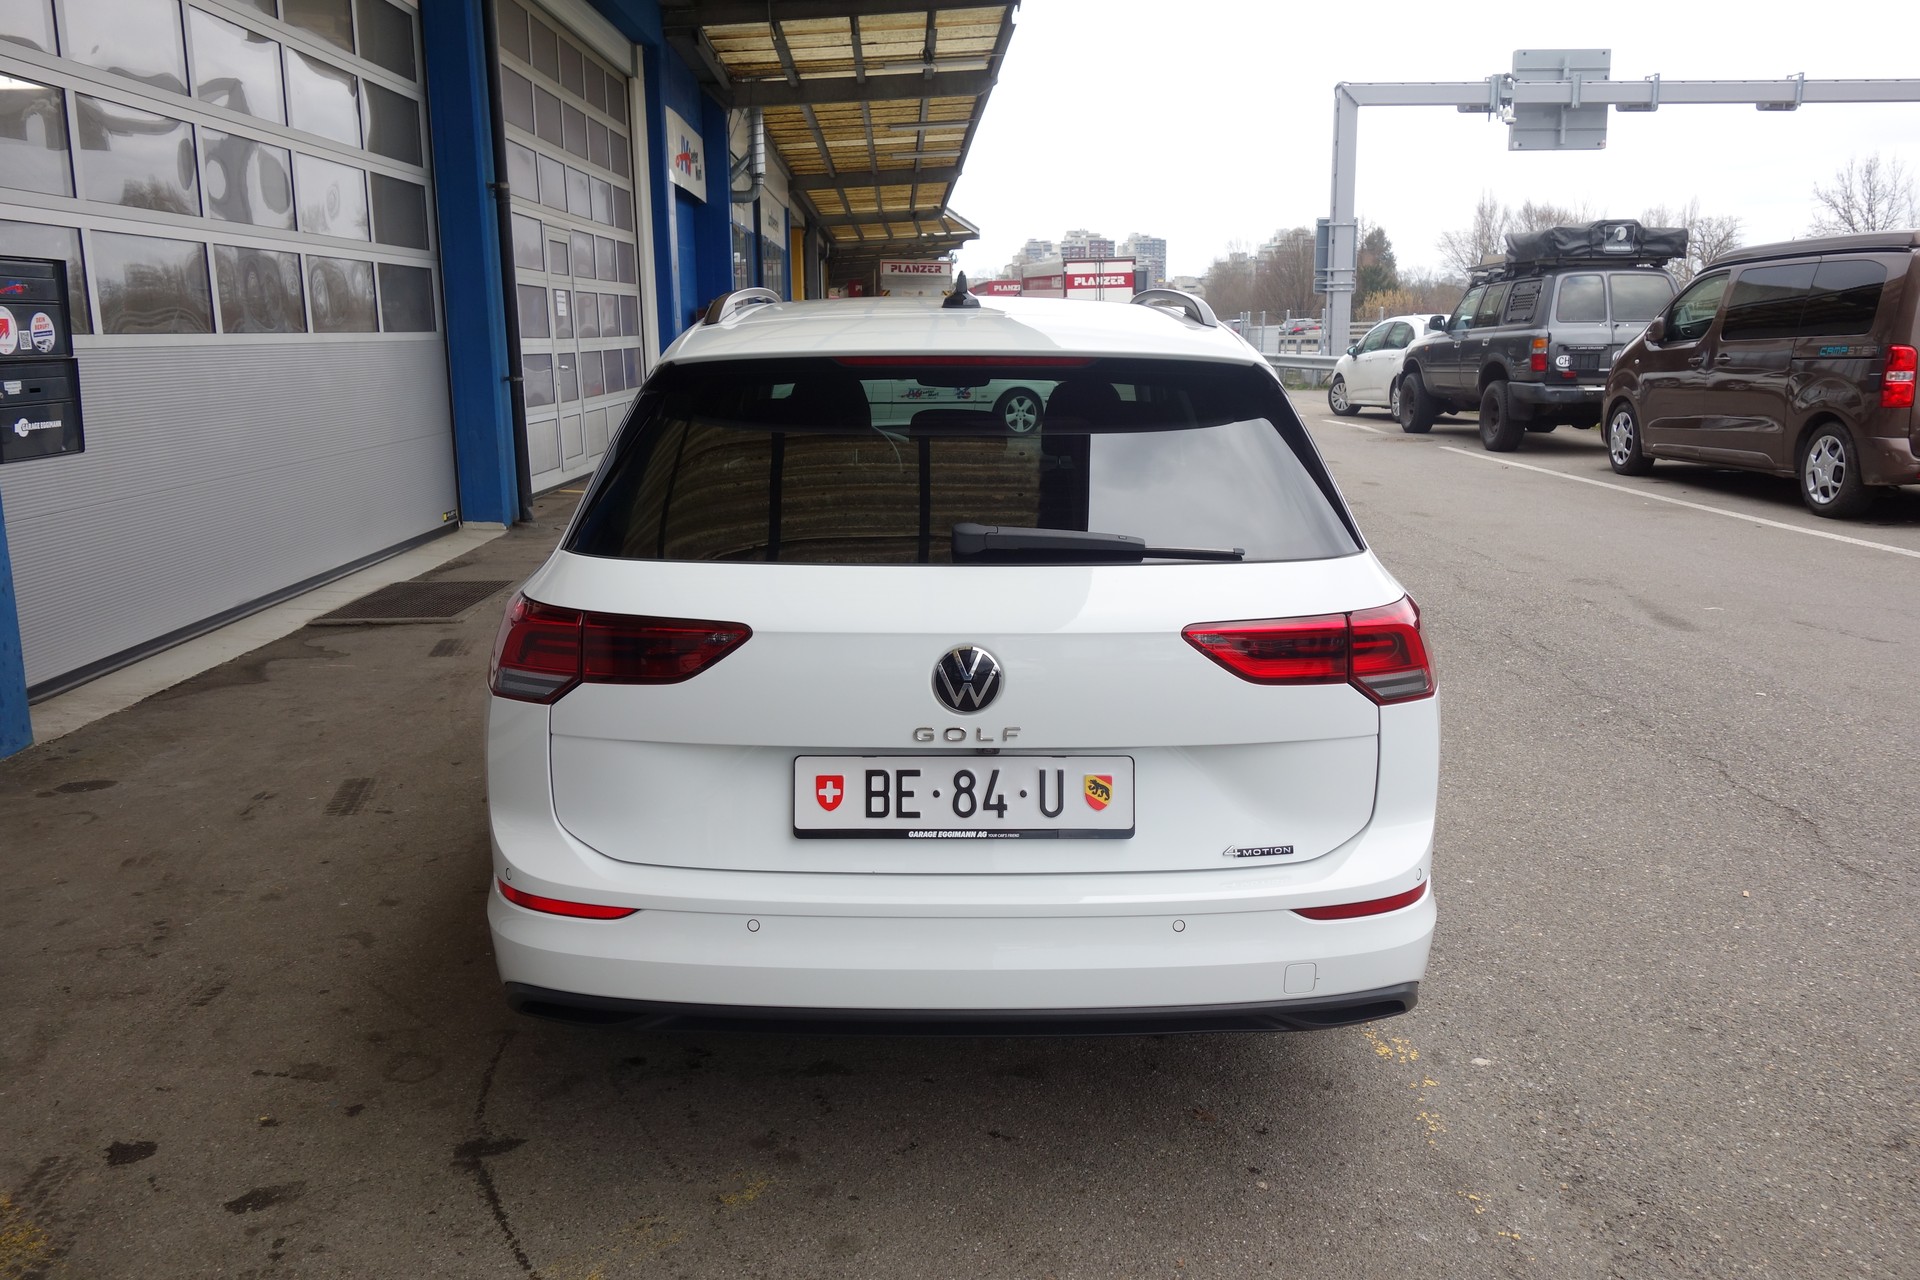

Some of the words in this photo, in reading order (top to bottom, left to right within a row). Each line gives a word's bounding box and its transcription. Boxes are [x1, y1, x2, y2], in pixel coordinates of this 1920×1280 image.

[891, 265, 941, 273] PLANZER
[1073, 276, 1126, 287] PLANZER
[1558, 356, 1570, 366] CH
[912, 726, 1022, 742] GOLF
